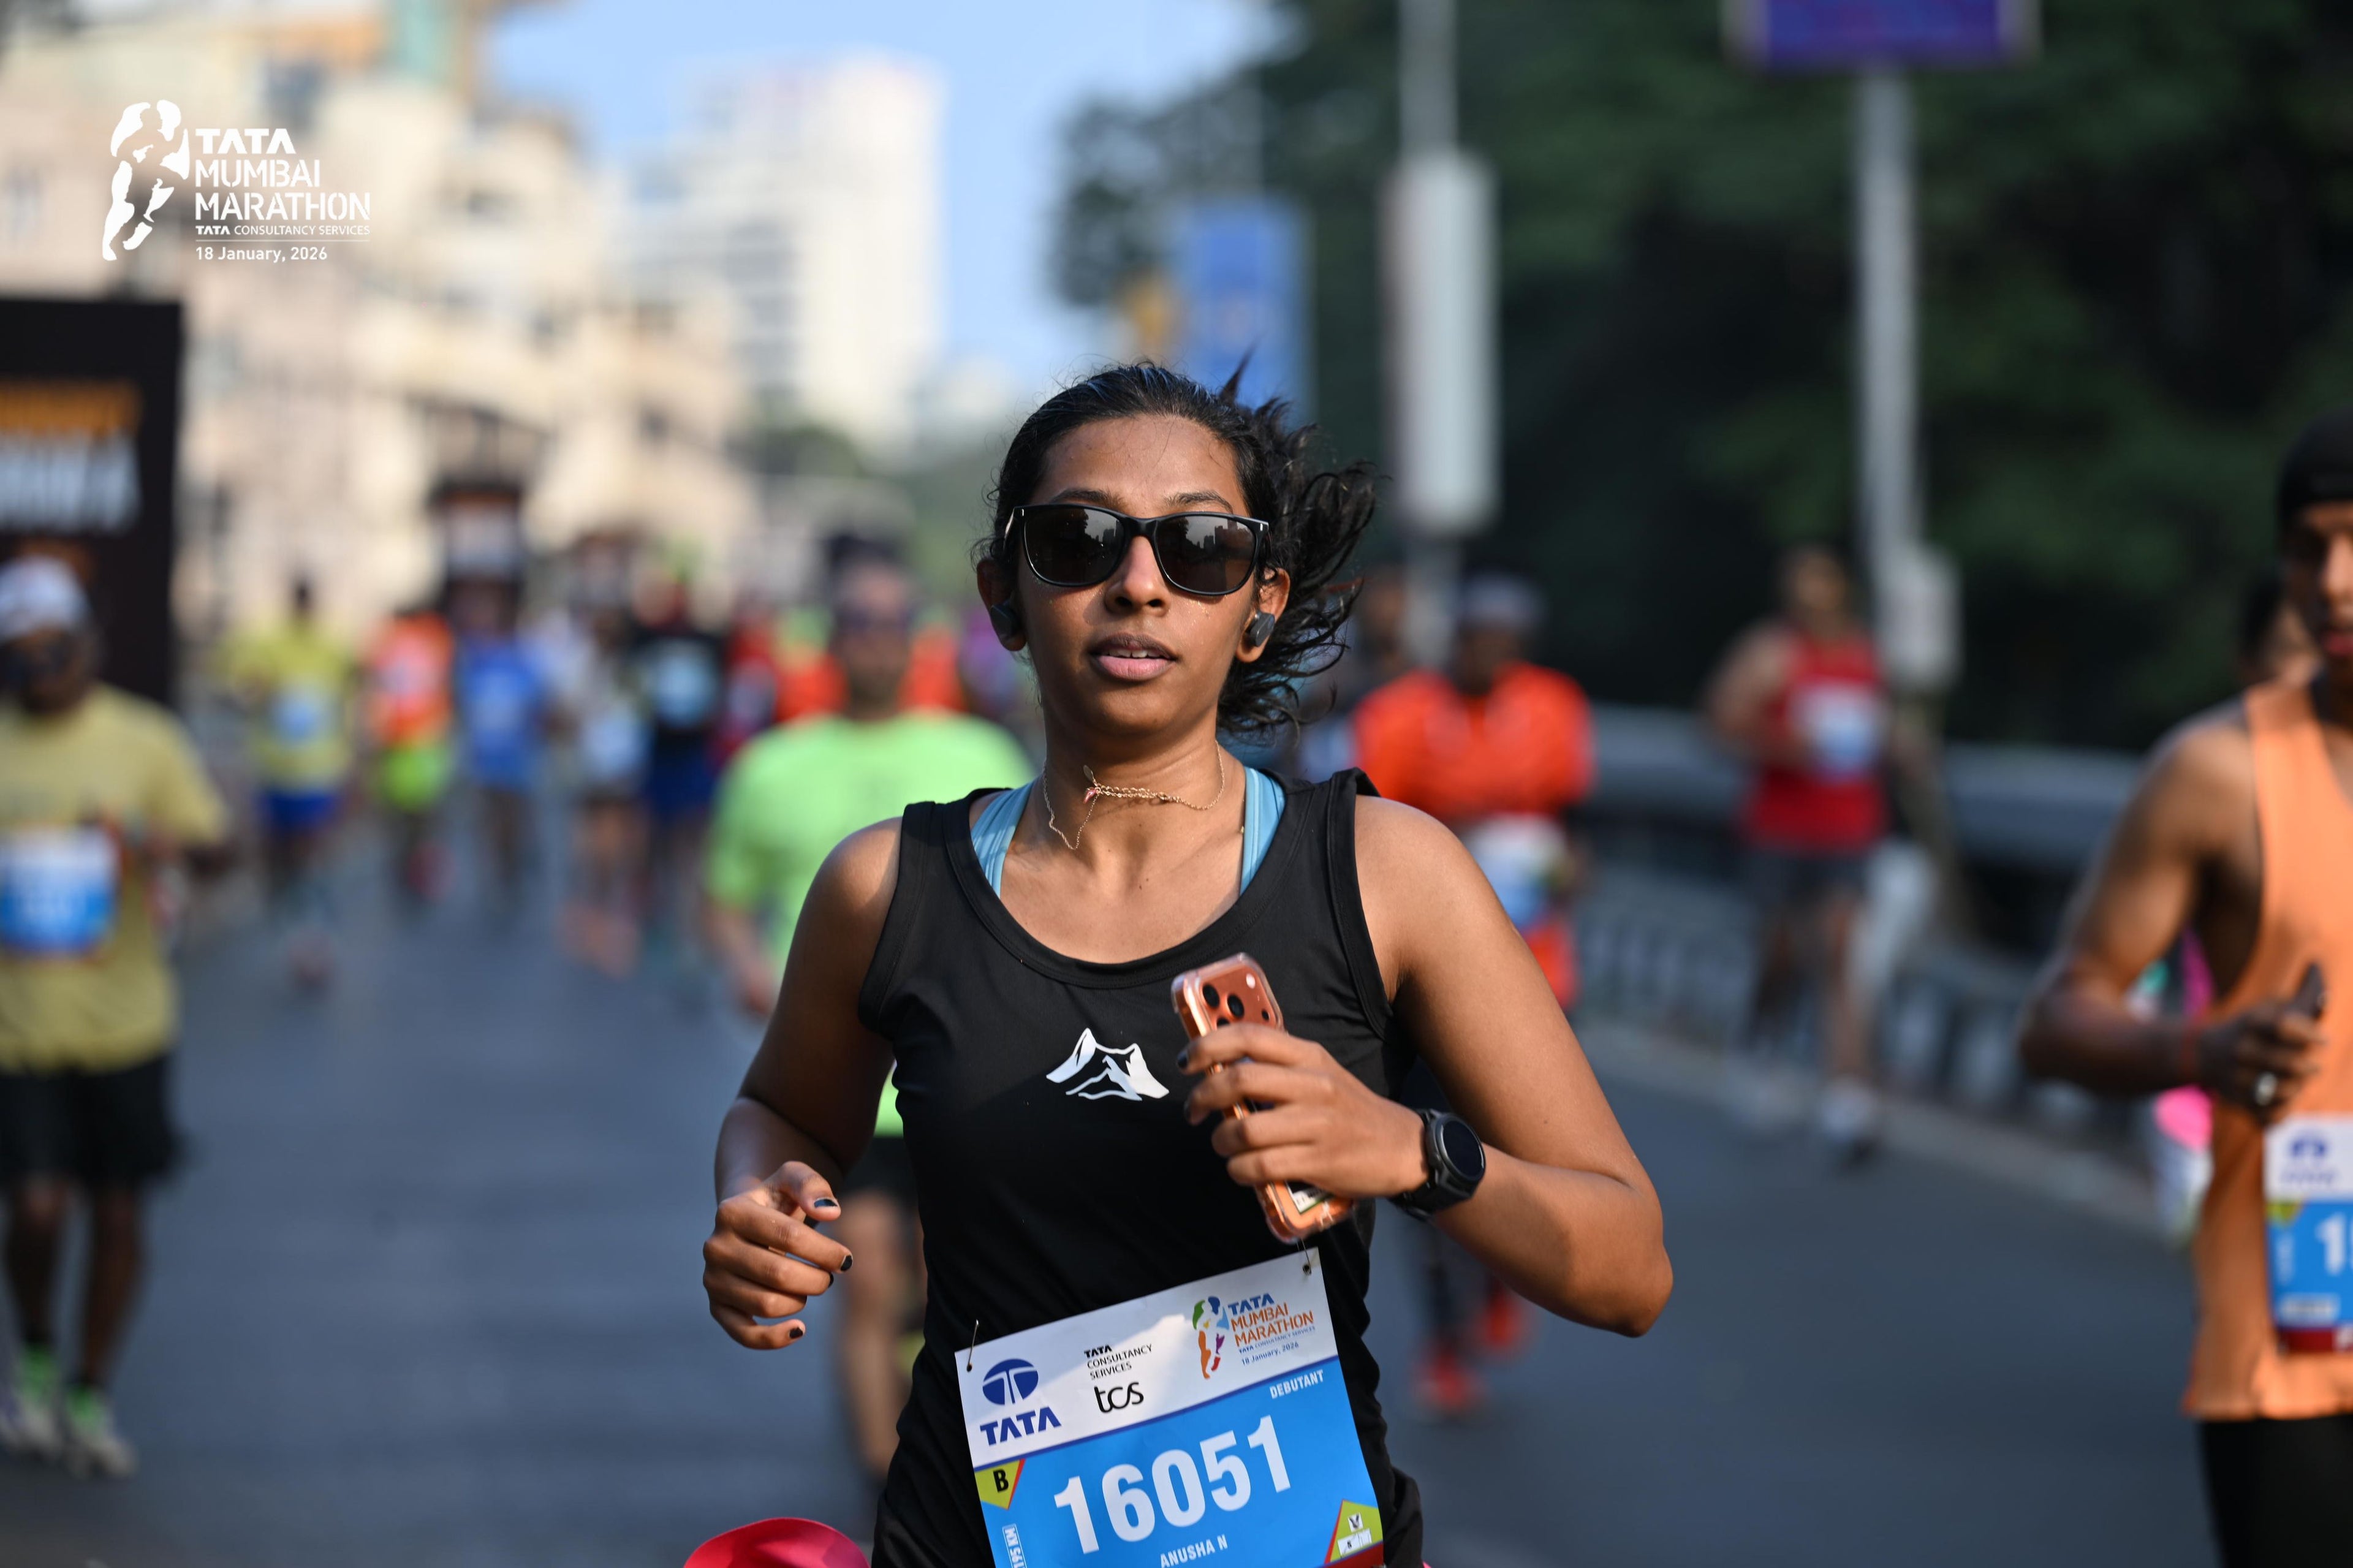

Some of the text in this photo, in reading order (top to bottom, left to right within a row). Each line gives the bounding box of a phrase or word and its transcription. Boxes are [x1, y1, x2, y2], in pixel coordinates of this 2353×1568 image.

[1227, 1293, 1275, 1316] TATA
[1230, 1301, 1289, 1332] MUMBAI
[1234, 1309, 1314, 1347] MARATHON
[1239, 1325, 1316, 1354] TATA CONSULTANCY SERVICES
[1083, 1344, 1113, 1359] TATA
[1087, 1343, 1152, 1369] CONSULTANCY
[1241, 1341, 1299, 1366] 18 January, 2026
[1090, 1361, 1132, 1381] SERVICES
[1269, 1368, 1324, 1399] DEBUTANT
[1094, 1381, 1145, 1414] tcs
[979, 1405, 1062, 1447] TATA
[993, 1468, 1009, 1493] B
[1054, 1414, 1291, 1555] 16051
[1160, 1534, 1229, 1568] ANUSHA N
